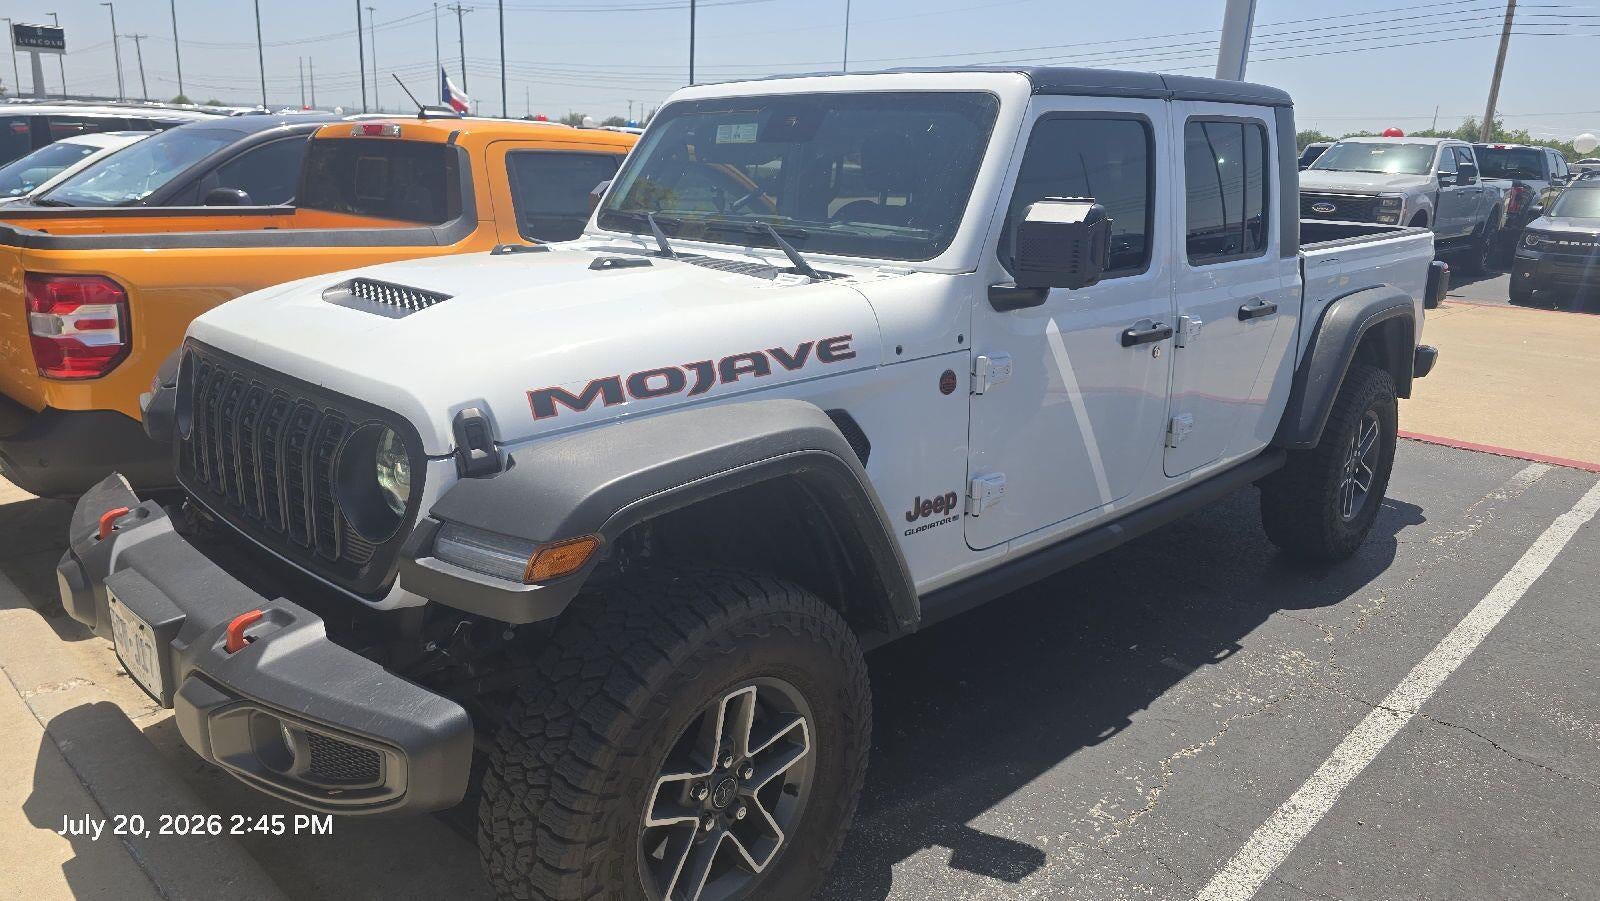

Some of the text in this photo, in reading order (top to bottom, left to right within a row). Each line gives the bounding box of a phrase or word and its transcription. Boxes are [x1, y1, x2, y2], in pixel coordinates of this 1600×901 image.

[526, 334, 856, 421] MOJAVE
[906, 491, 957, 522] Jeep
[904, 517, 951, 536] GLADIATOR
